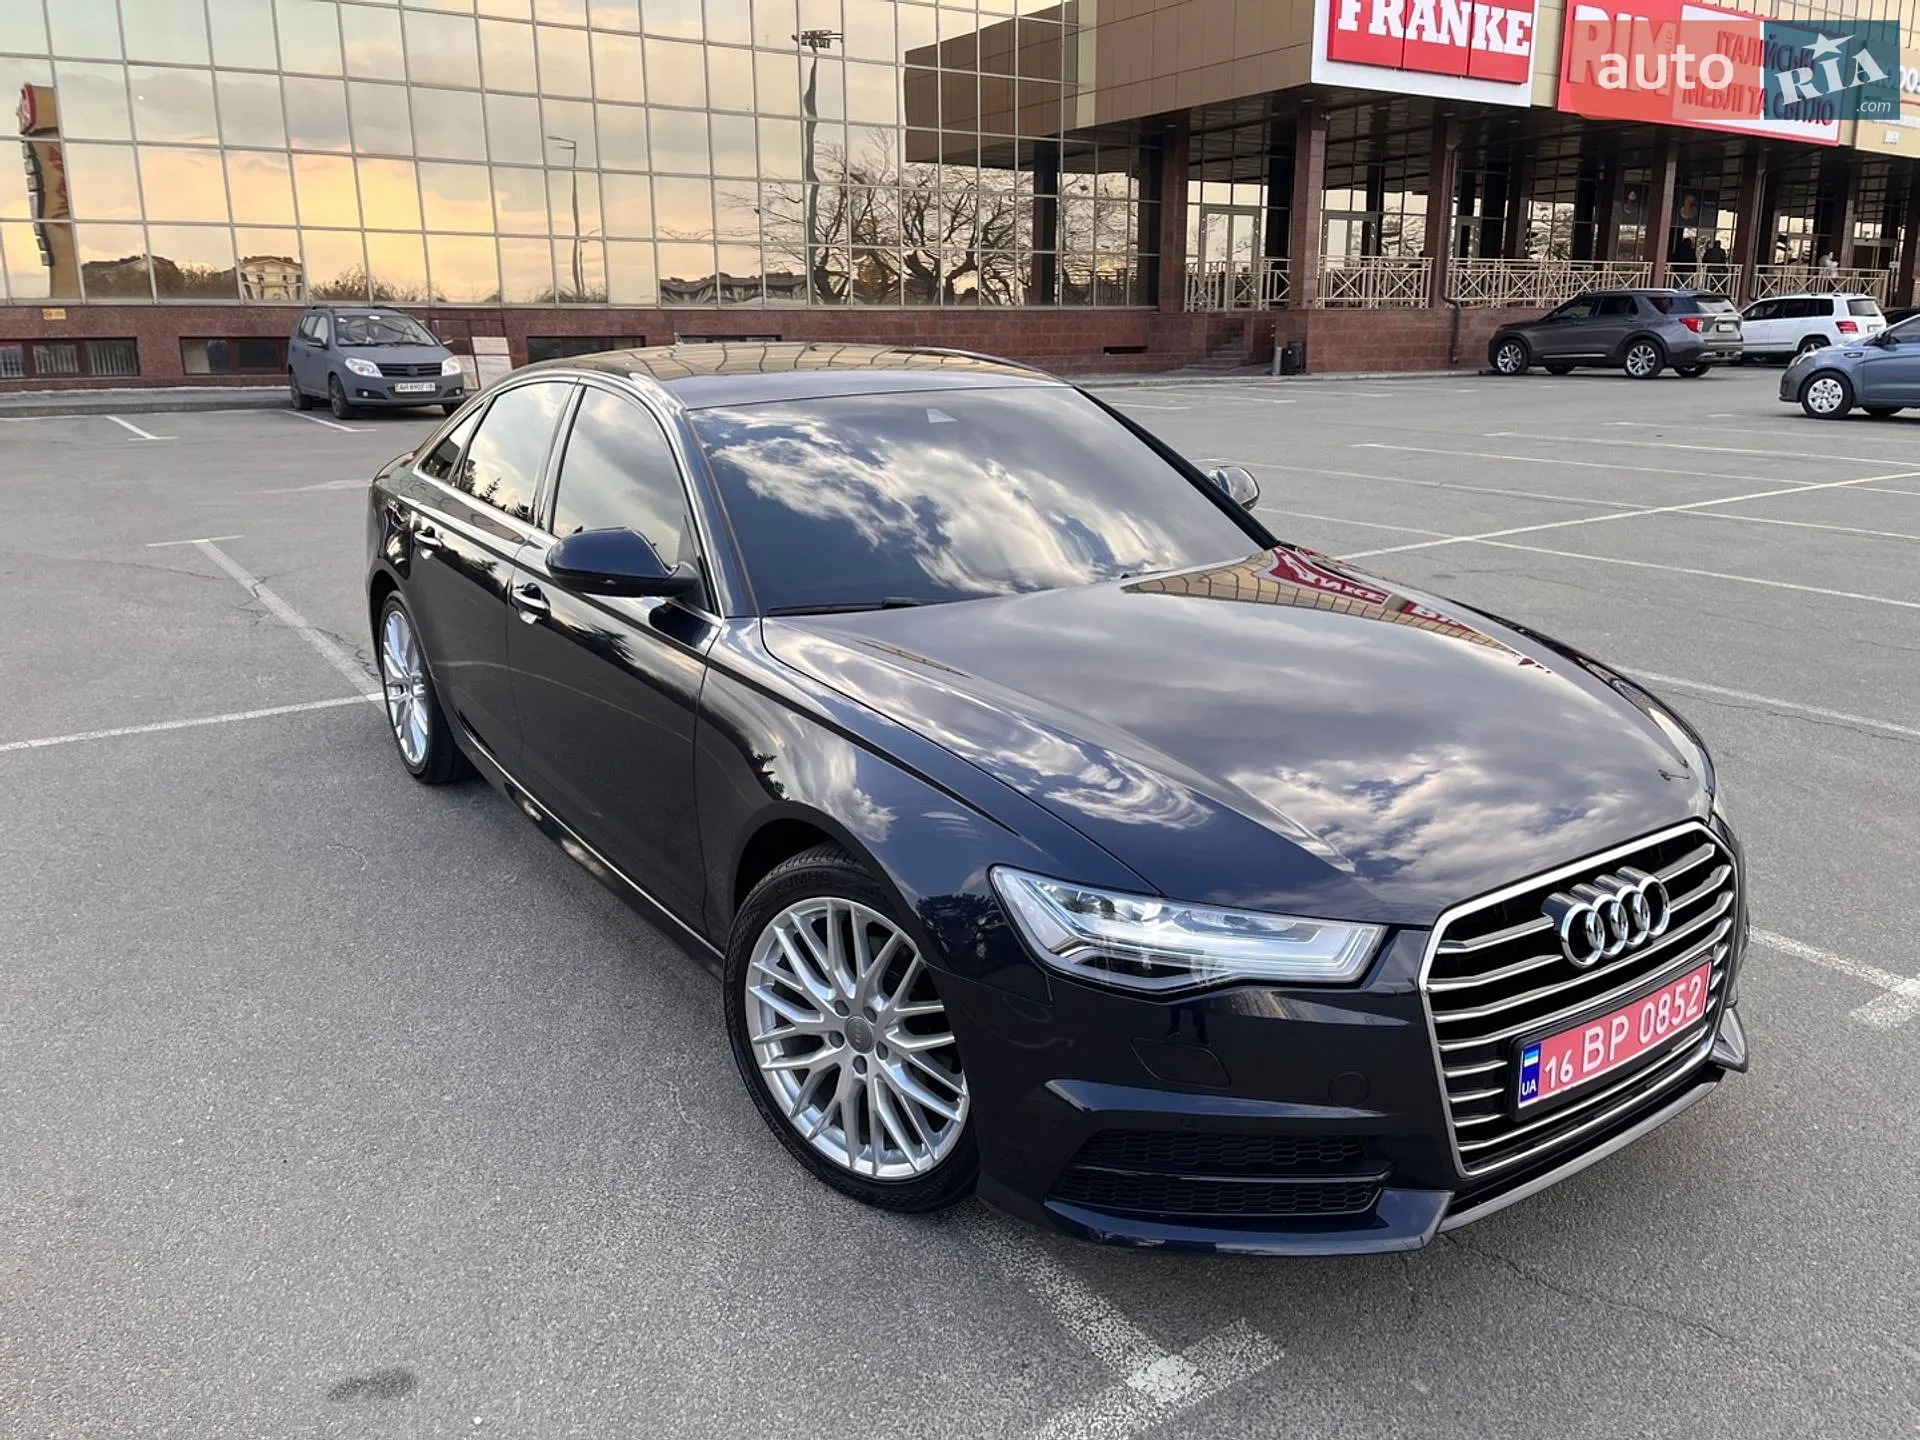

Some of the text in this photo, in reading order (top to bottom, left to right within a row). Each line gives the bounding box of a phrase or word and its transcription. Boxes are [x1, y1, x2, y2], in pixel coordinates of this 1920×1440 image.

[1337, 0, 1533, 56] FRANKE
[1568, 4, 1678, 96] RIM
[1543, 974, 1702, 1089] 16 BP 0852
[1521, 1078, 1537, 1096] UA
